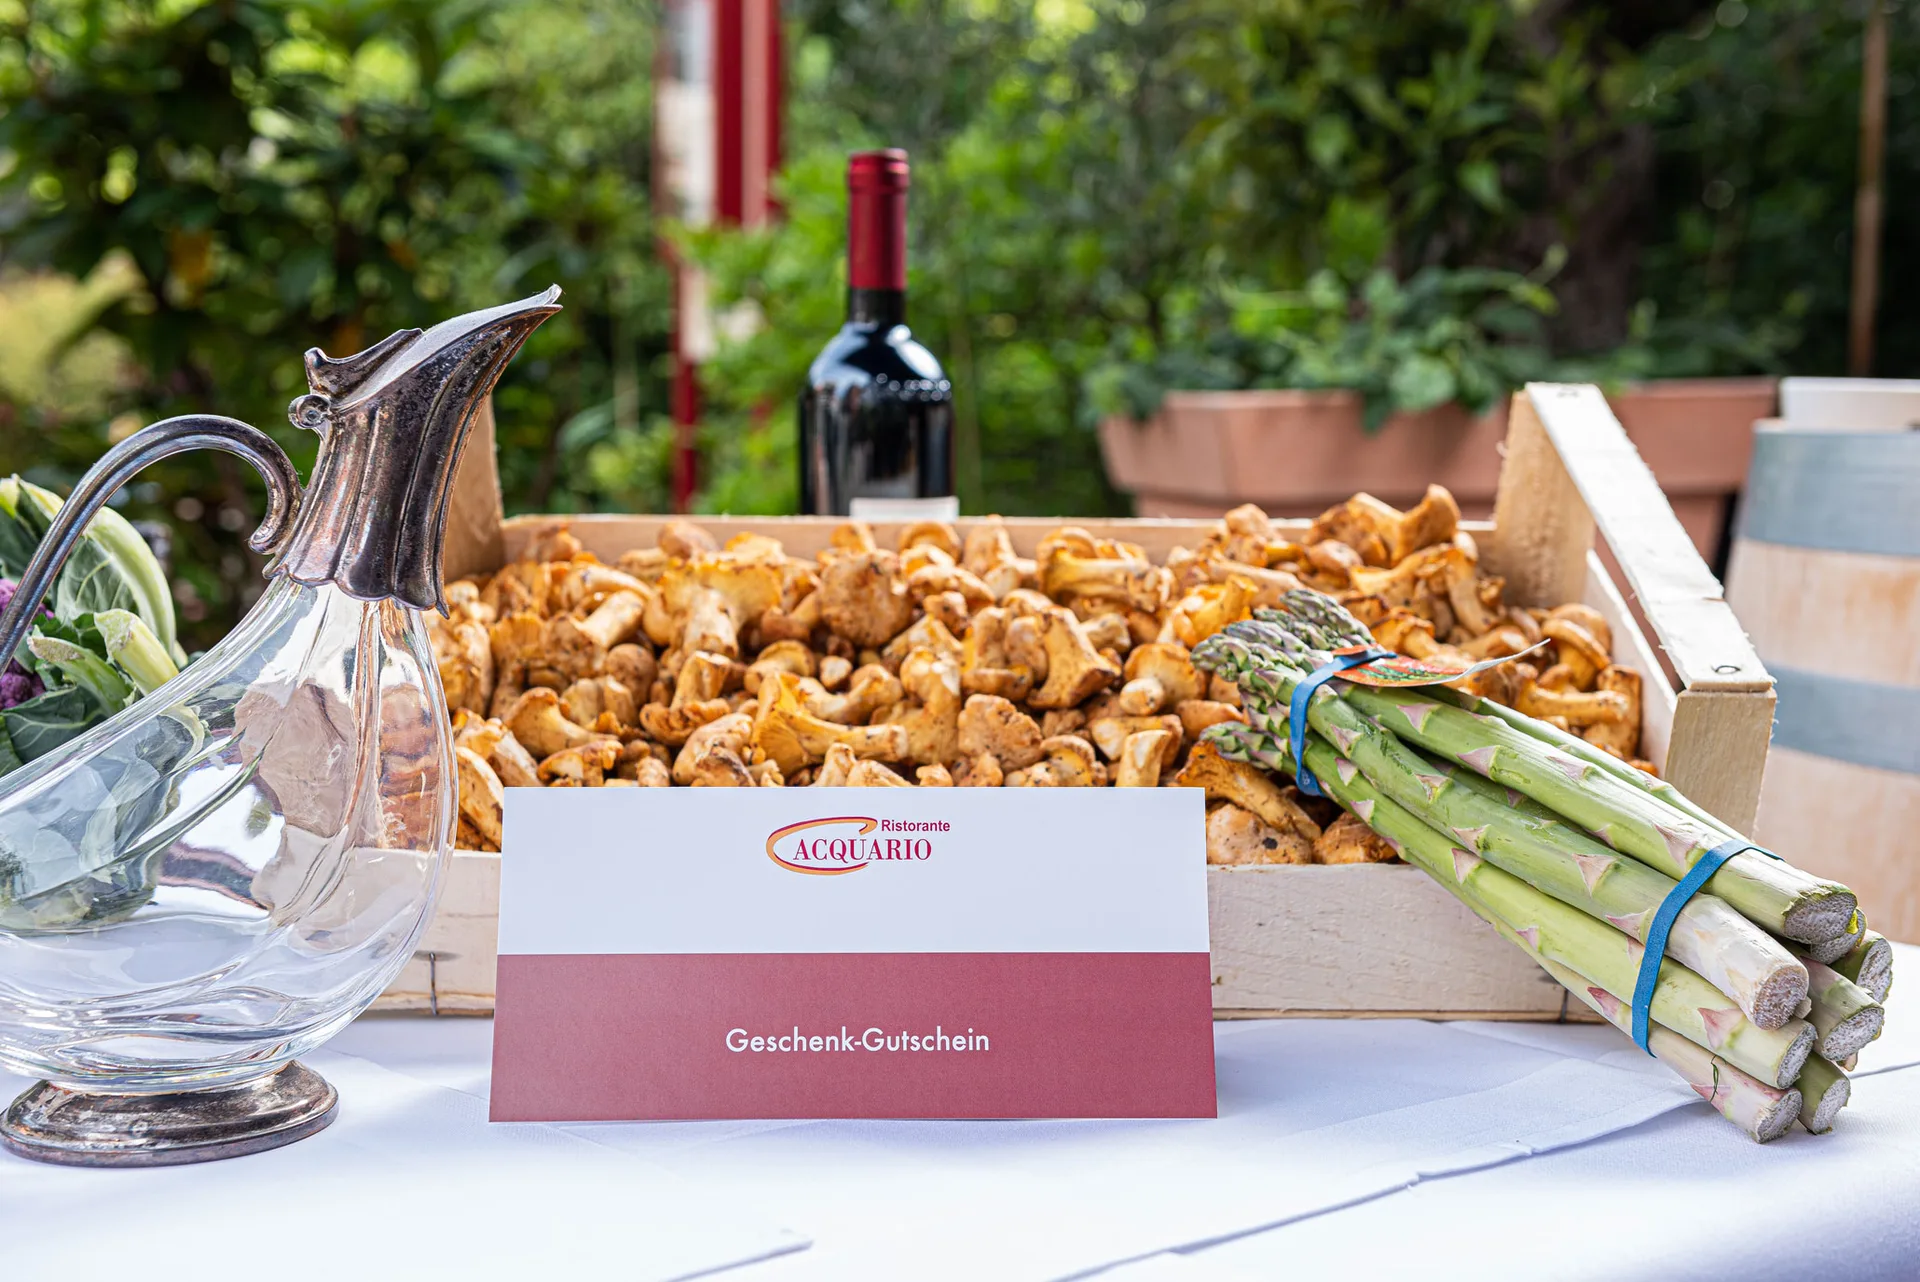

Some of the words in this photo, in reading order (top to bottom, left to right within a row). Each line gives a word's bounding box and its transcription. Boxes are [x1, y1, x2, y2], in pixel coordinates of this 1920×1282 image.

[881, 819, 951, 832] Ristorante
[792, 838, 933, 863] ACQUARIO
[725, 1025, 990, 1052] Geschenk-Gutschein
